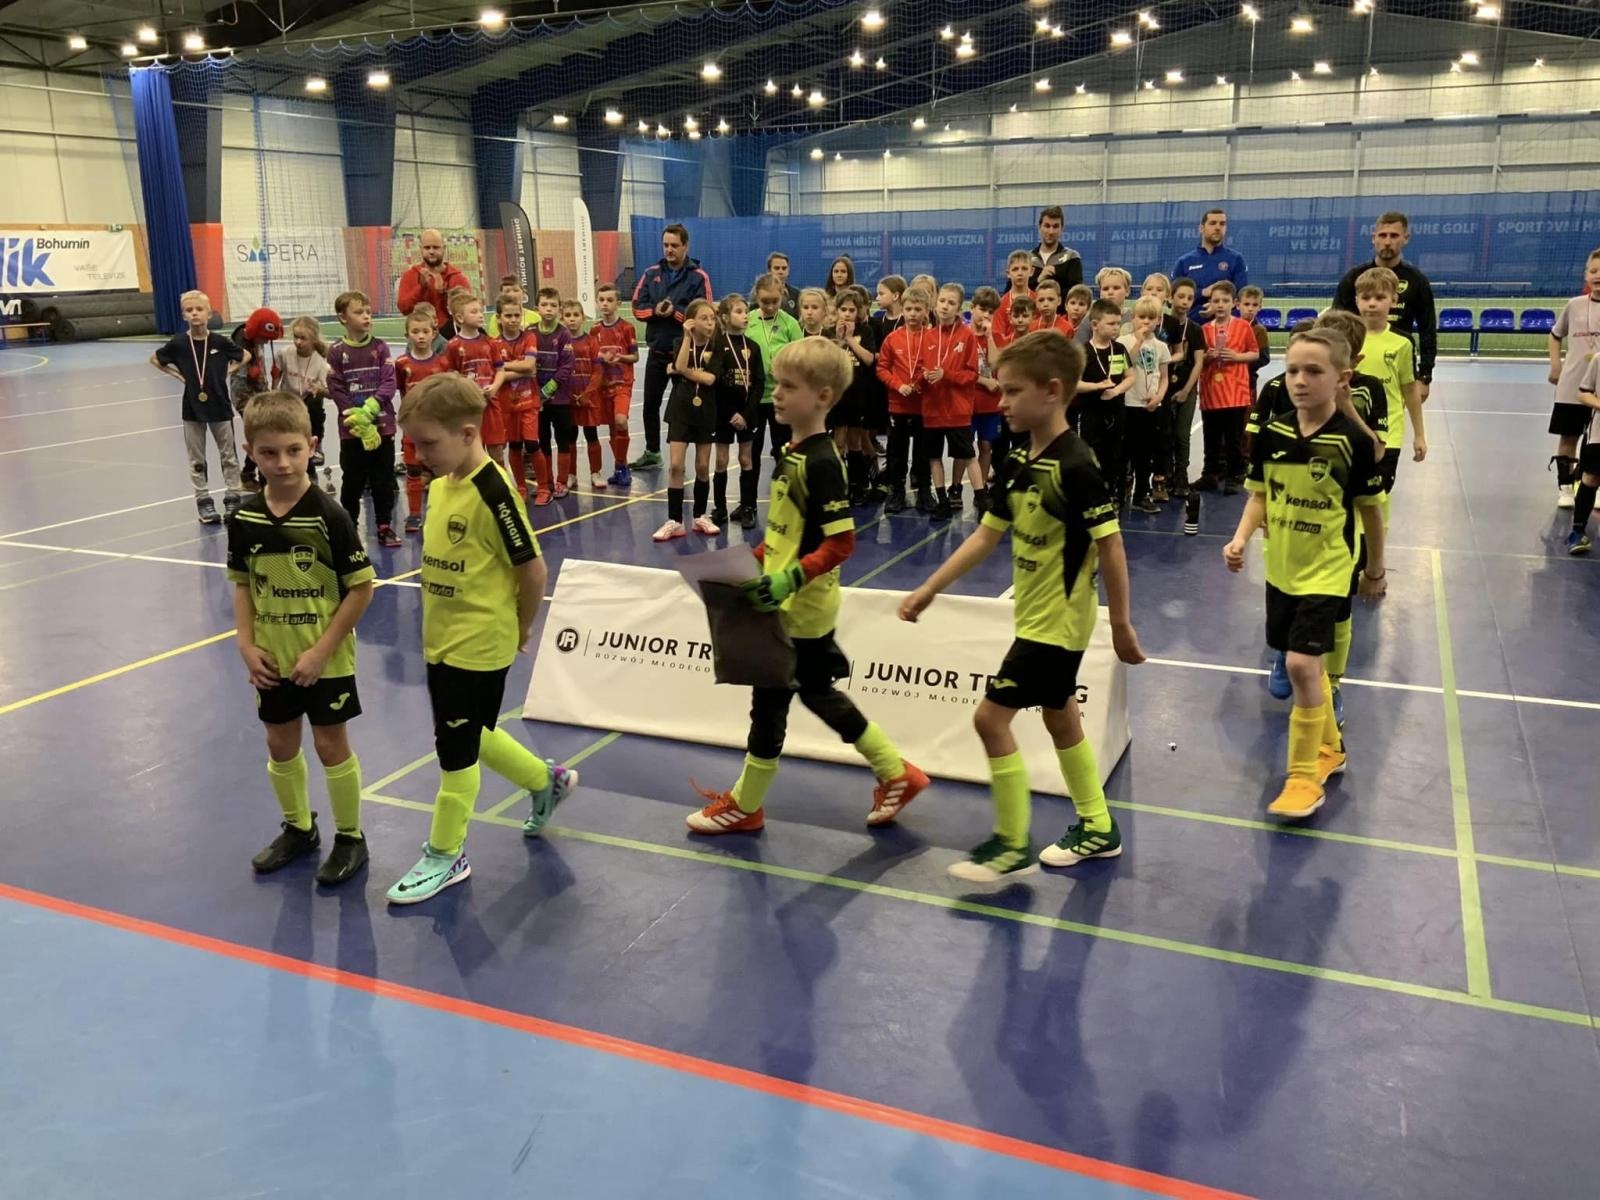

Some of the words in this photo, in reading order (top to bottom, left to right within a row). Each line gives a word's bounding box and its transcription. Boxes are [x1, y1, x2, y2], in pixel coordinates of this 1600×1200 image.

[946, 233, 985, 245] STEZKA
[272, 585, 325, 598] kensol
[598, 630, 679, 656] JUNIOR
[595, 653, 645, 665] ROZWÓJ
[864, 662, 959, 689] JUNIOR
[861, 685, 920, 698] ROZWÓJ
[928, 693, 978, 706] MŁODE
